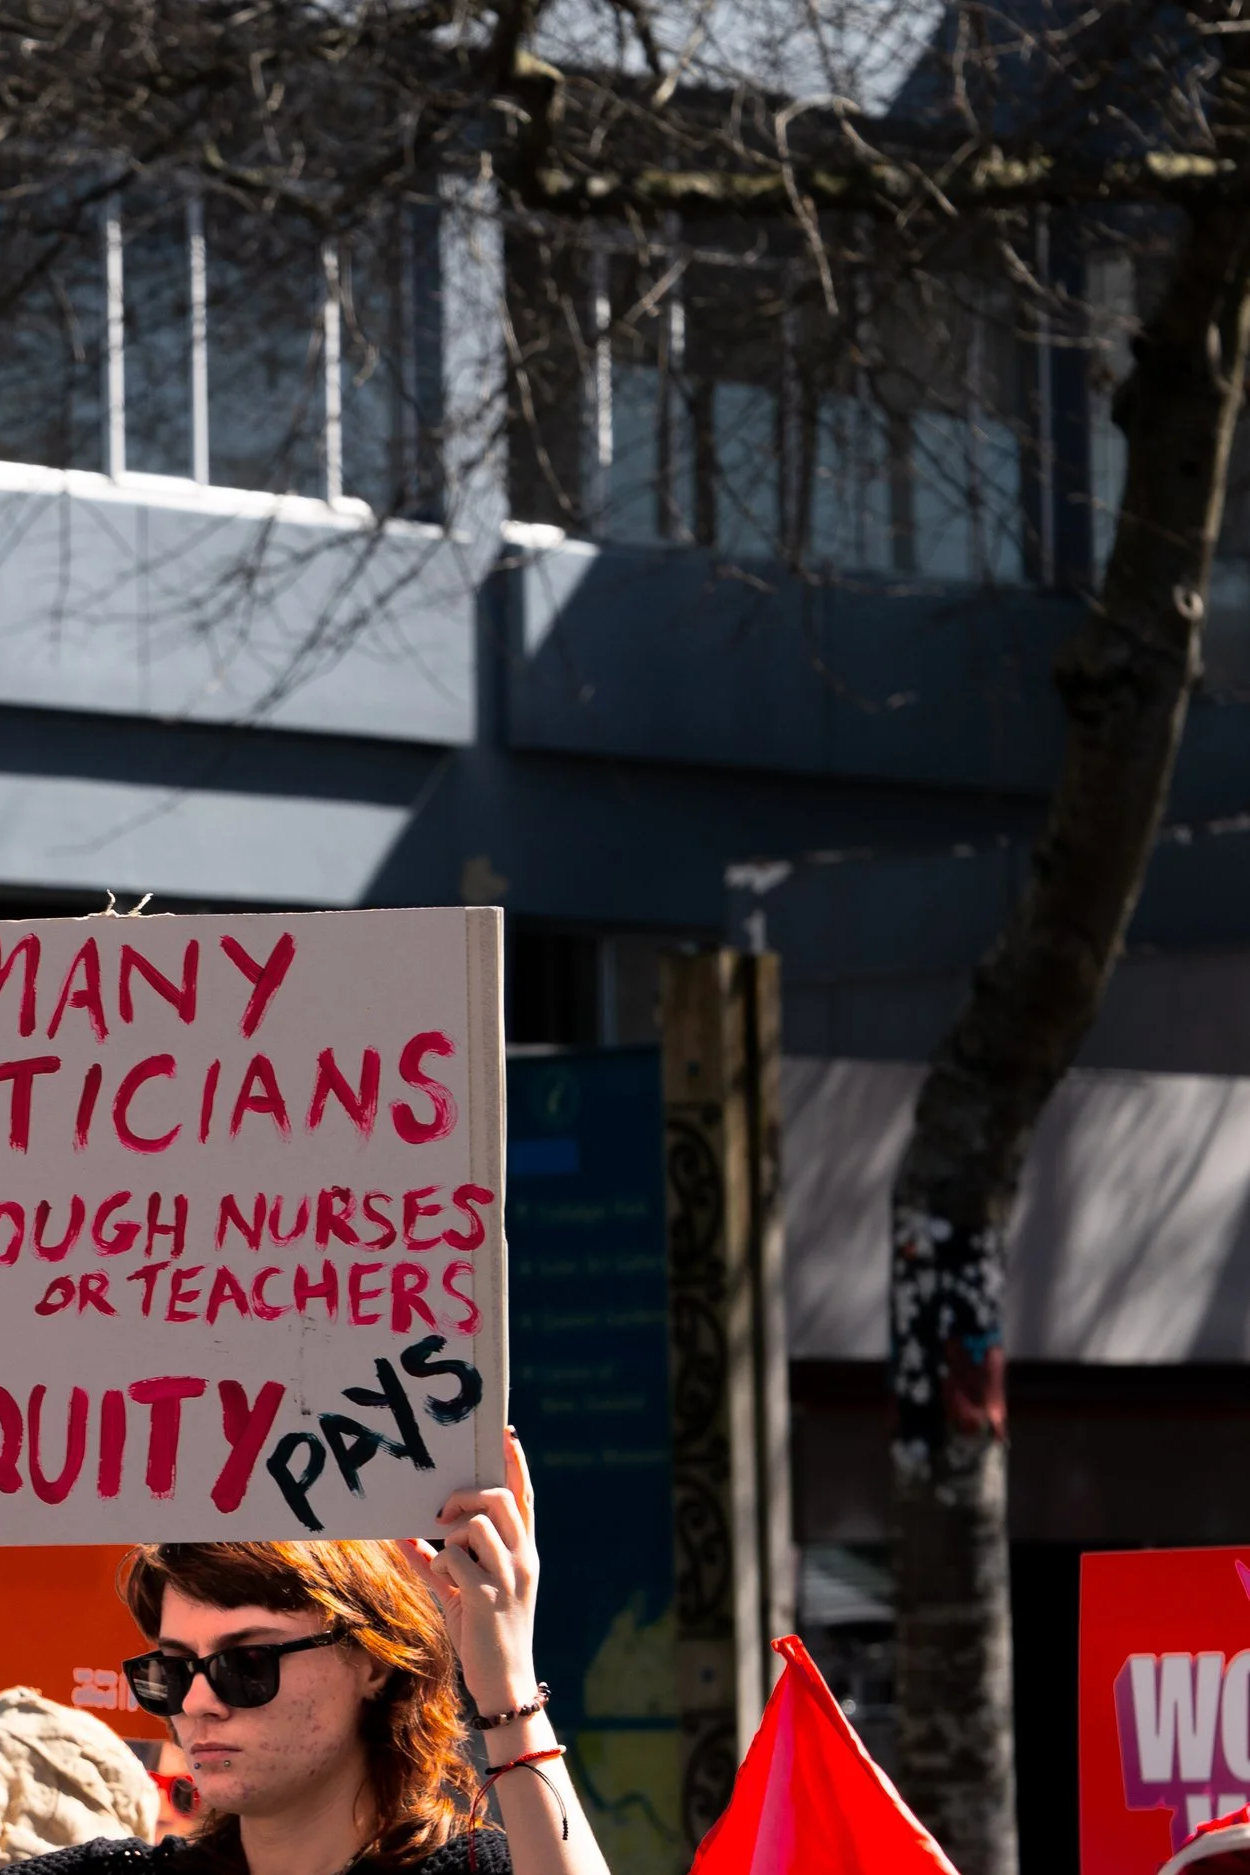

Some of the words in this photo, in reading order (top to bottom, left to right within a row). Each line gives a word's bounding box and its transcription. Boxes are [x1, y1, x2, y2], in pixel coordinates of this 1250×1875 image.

[213, 1182, 495, 1253] NURSES
[34, 1274, 118, 1318] OR
[127, 1260, 484, 1336] TEACHERS
[265, 1334, 484, 1532] PAYS
